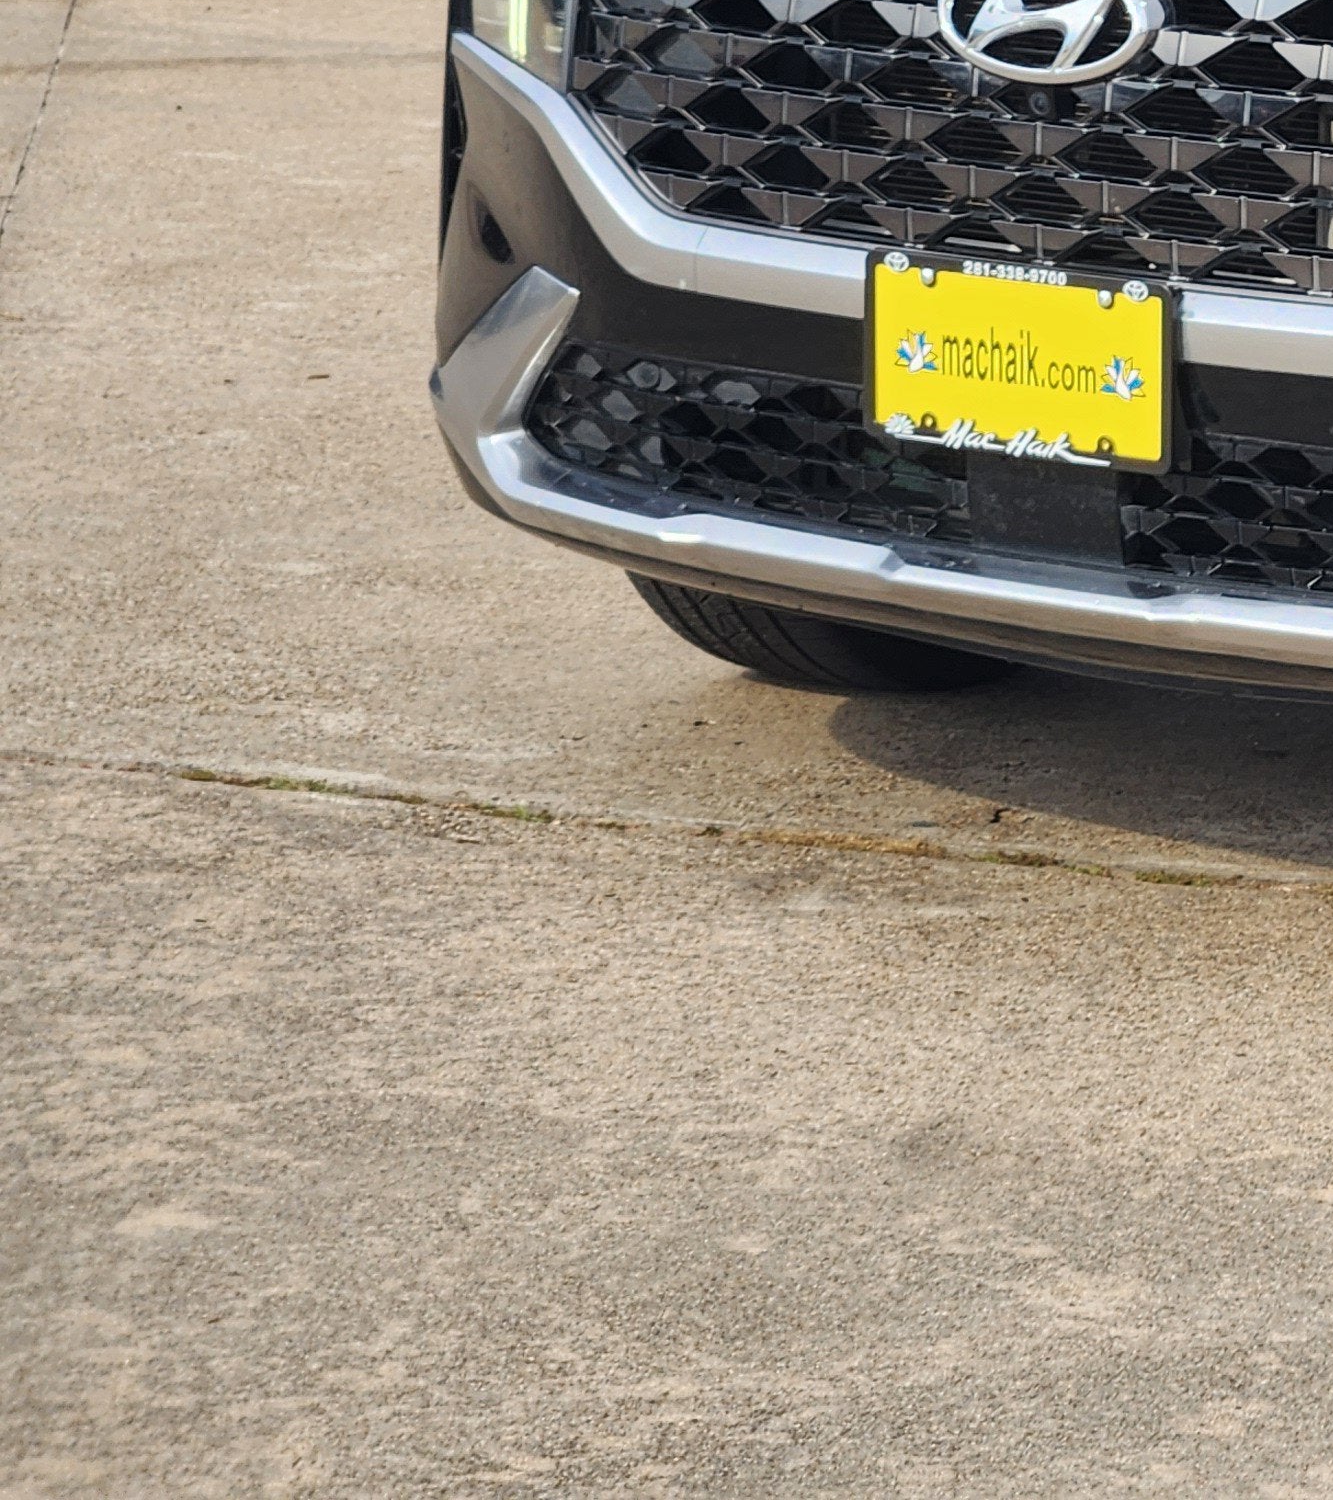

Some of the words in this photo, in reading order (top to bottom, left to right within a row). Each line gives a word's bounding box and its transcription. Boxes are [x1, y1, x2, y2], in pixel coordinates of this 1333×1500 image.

[963, 259, 1068, 286] 281-338-9700
[941, 326, 1097, 394] machaik.com
[942, 417, 1001, 450] Mac
[1005, 428, 1080, 461] Haik
